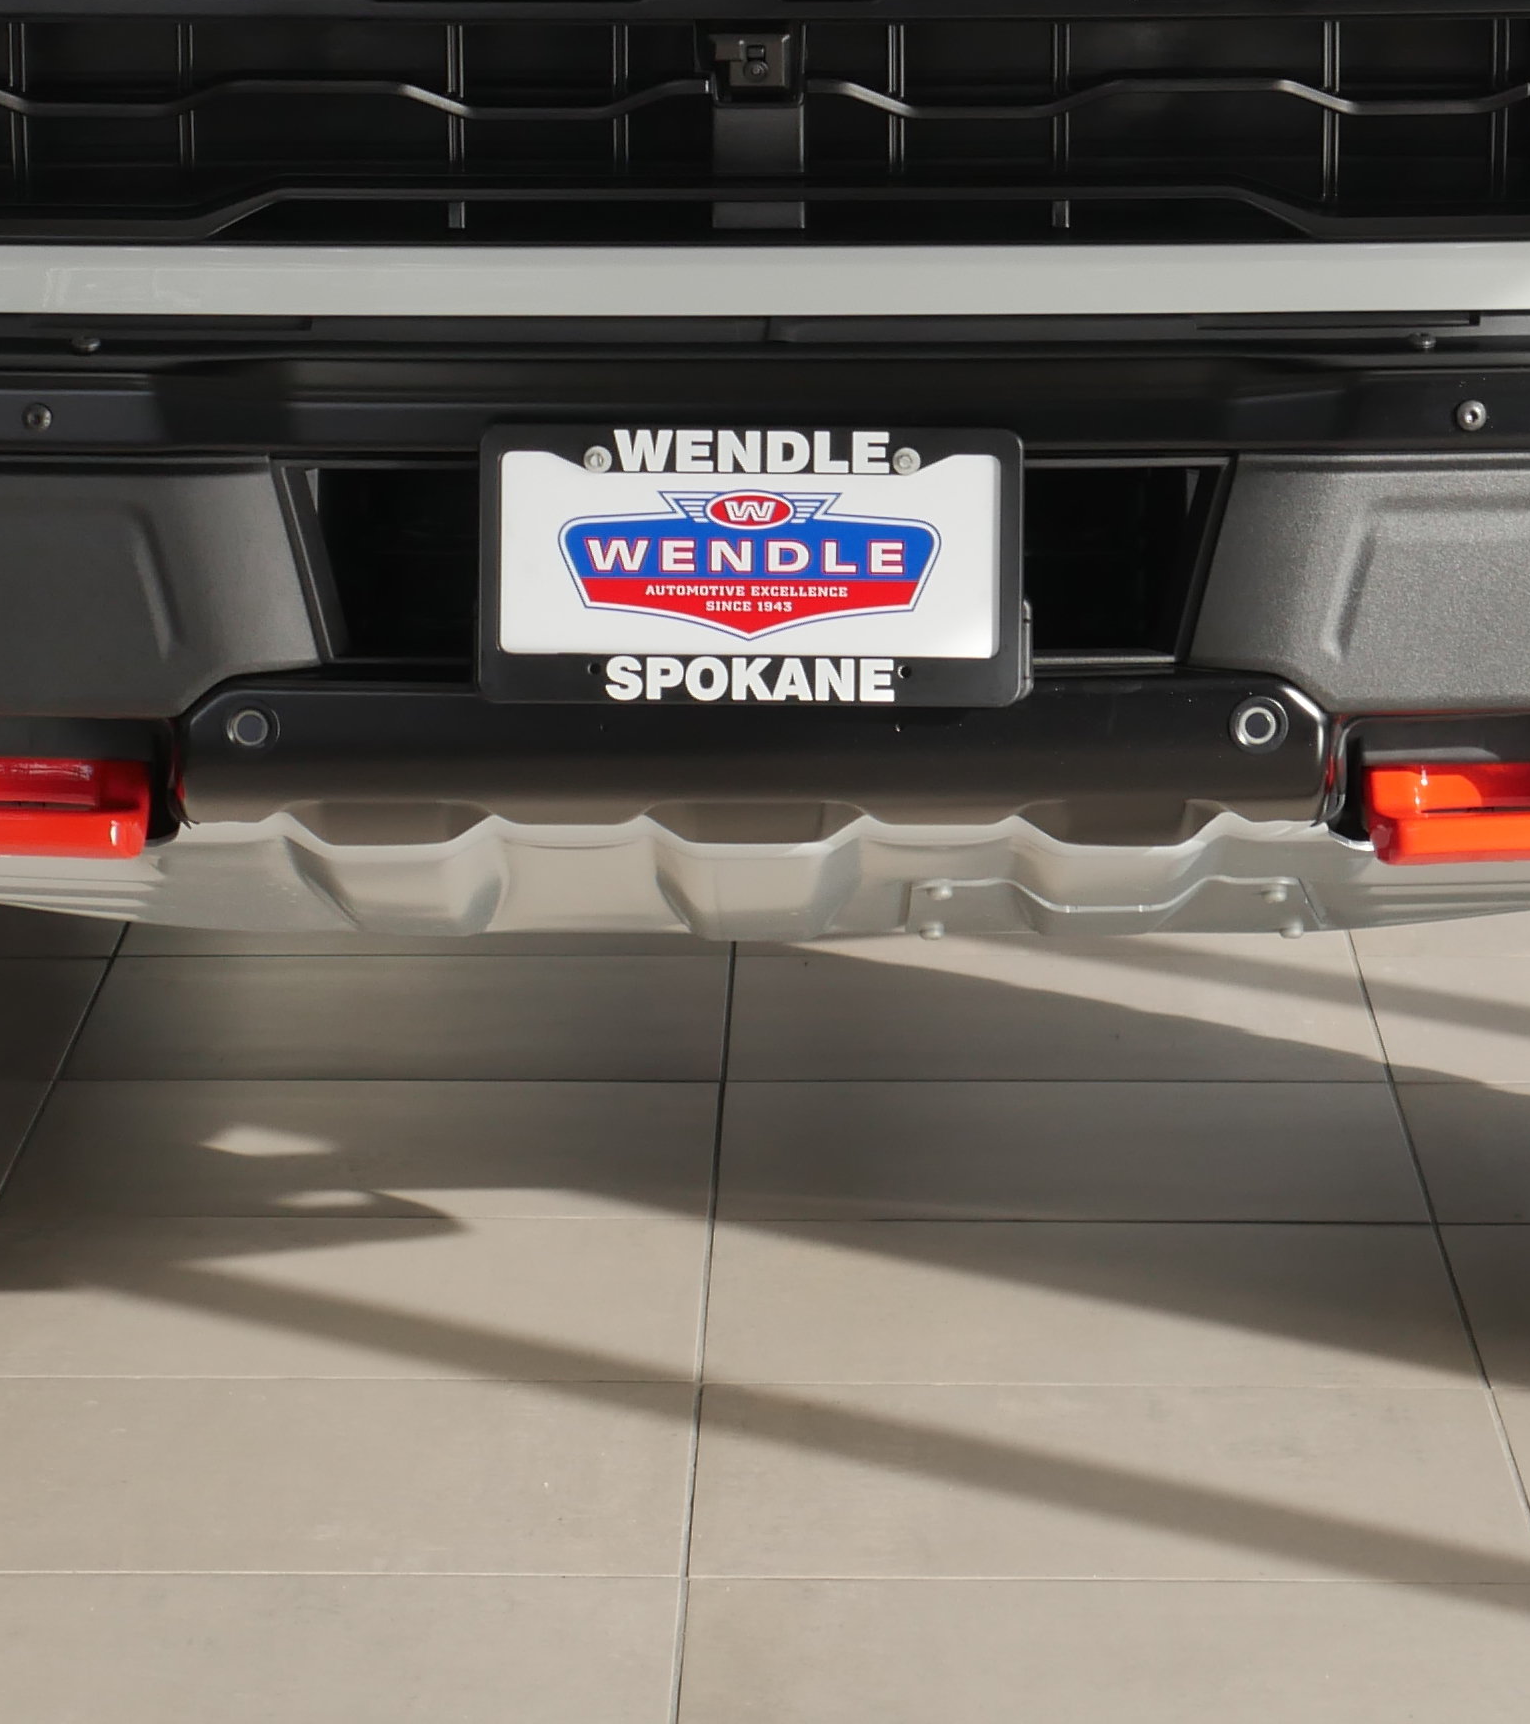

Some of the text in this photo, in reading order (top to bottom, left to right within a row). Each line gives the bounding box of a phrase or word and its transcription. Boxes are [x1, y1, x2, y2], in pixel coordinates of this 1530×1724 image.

[613, 429, 890, 474] WENDLE
[585, 538, 906, 574] WENDLE
[645, 585, 848, 598] AUTOMOTIVE EXCELLENCE
[705, 600, 793, 612] SINCE 1943
[605, 656, 895, 702] SPOKANE
